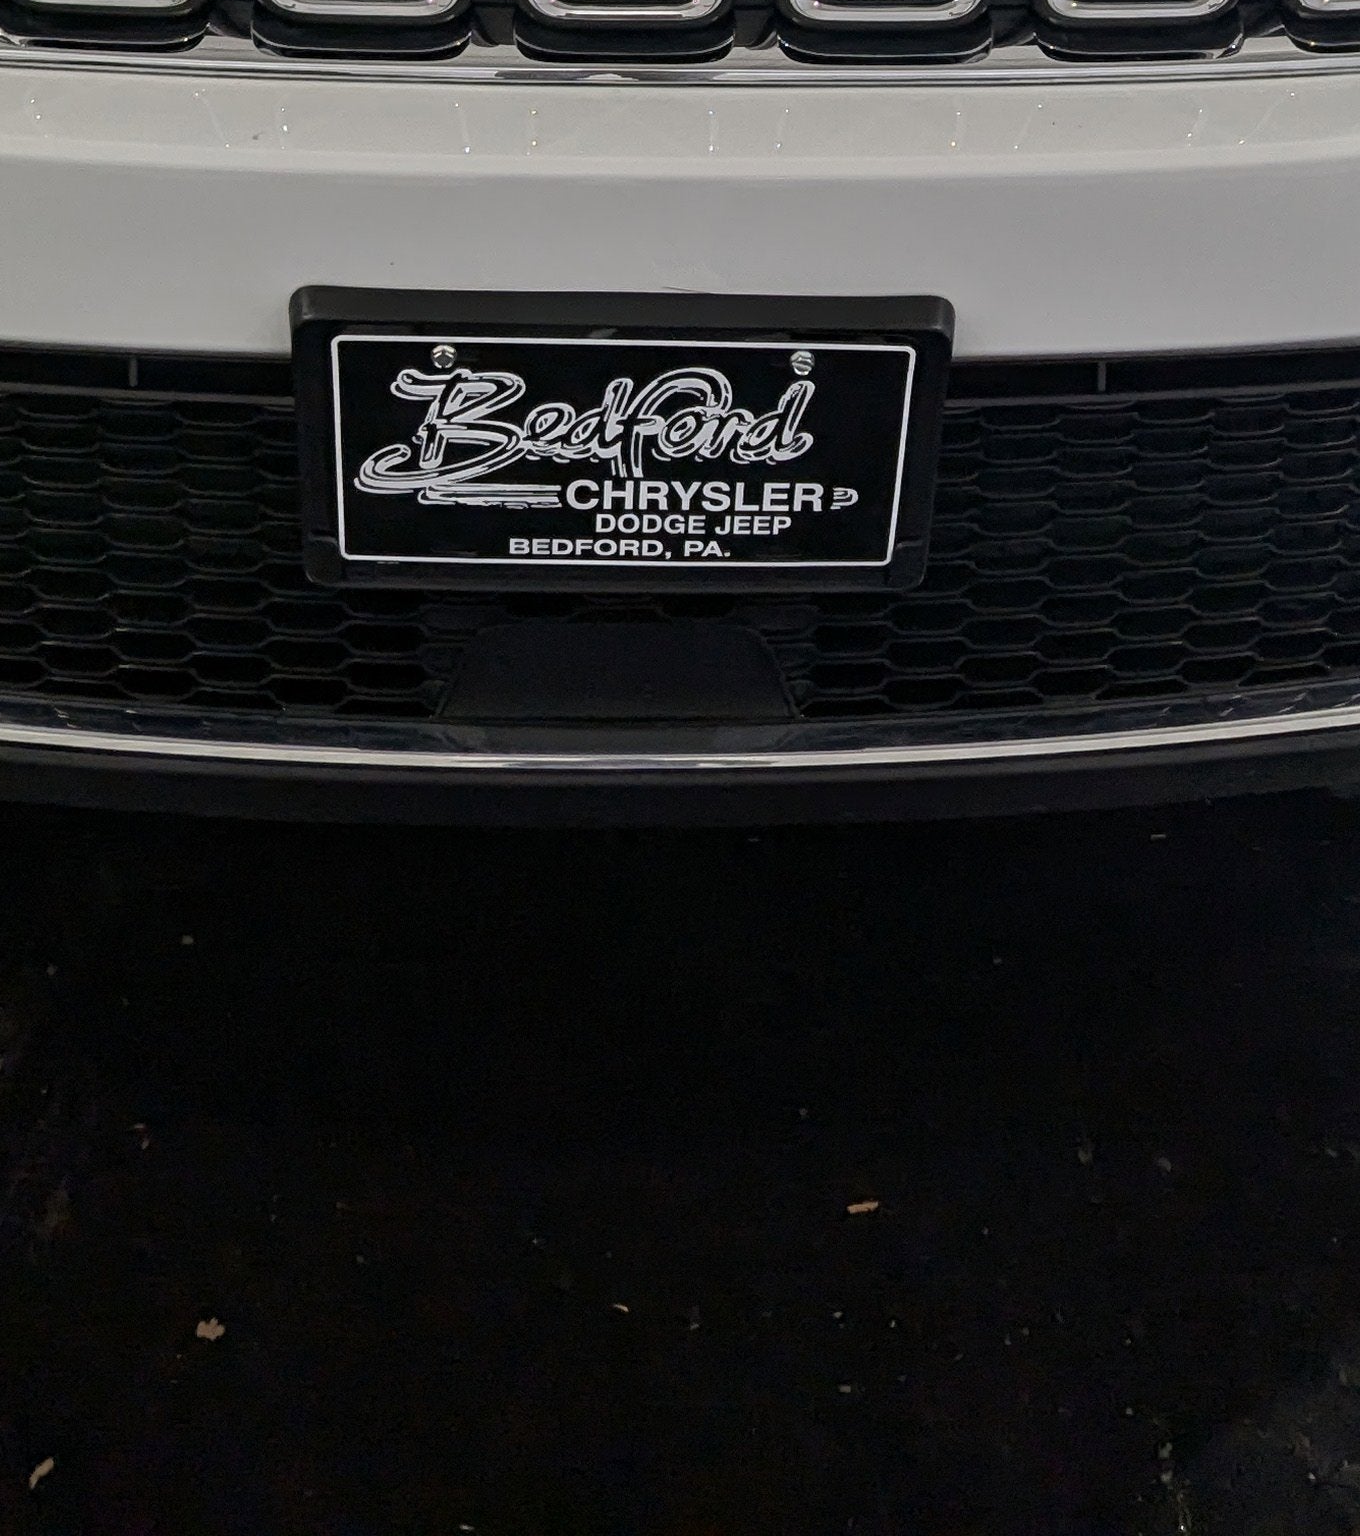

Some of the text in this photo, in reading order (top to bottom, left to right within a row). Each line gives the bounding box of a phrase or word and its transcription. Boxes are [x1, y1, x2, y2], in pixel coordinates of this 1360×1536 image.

[565, 479, 824, 513] CHRYSLER
[595, 513, 792, 536] DODGE JEEP
[508, 538, 731, 560] BEDFORD, PA.
